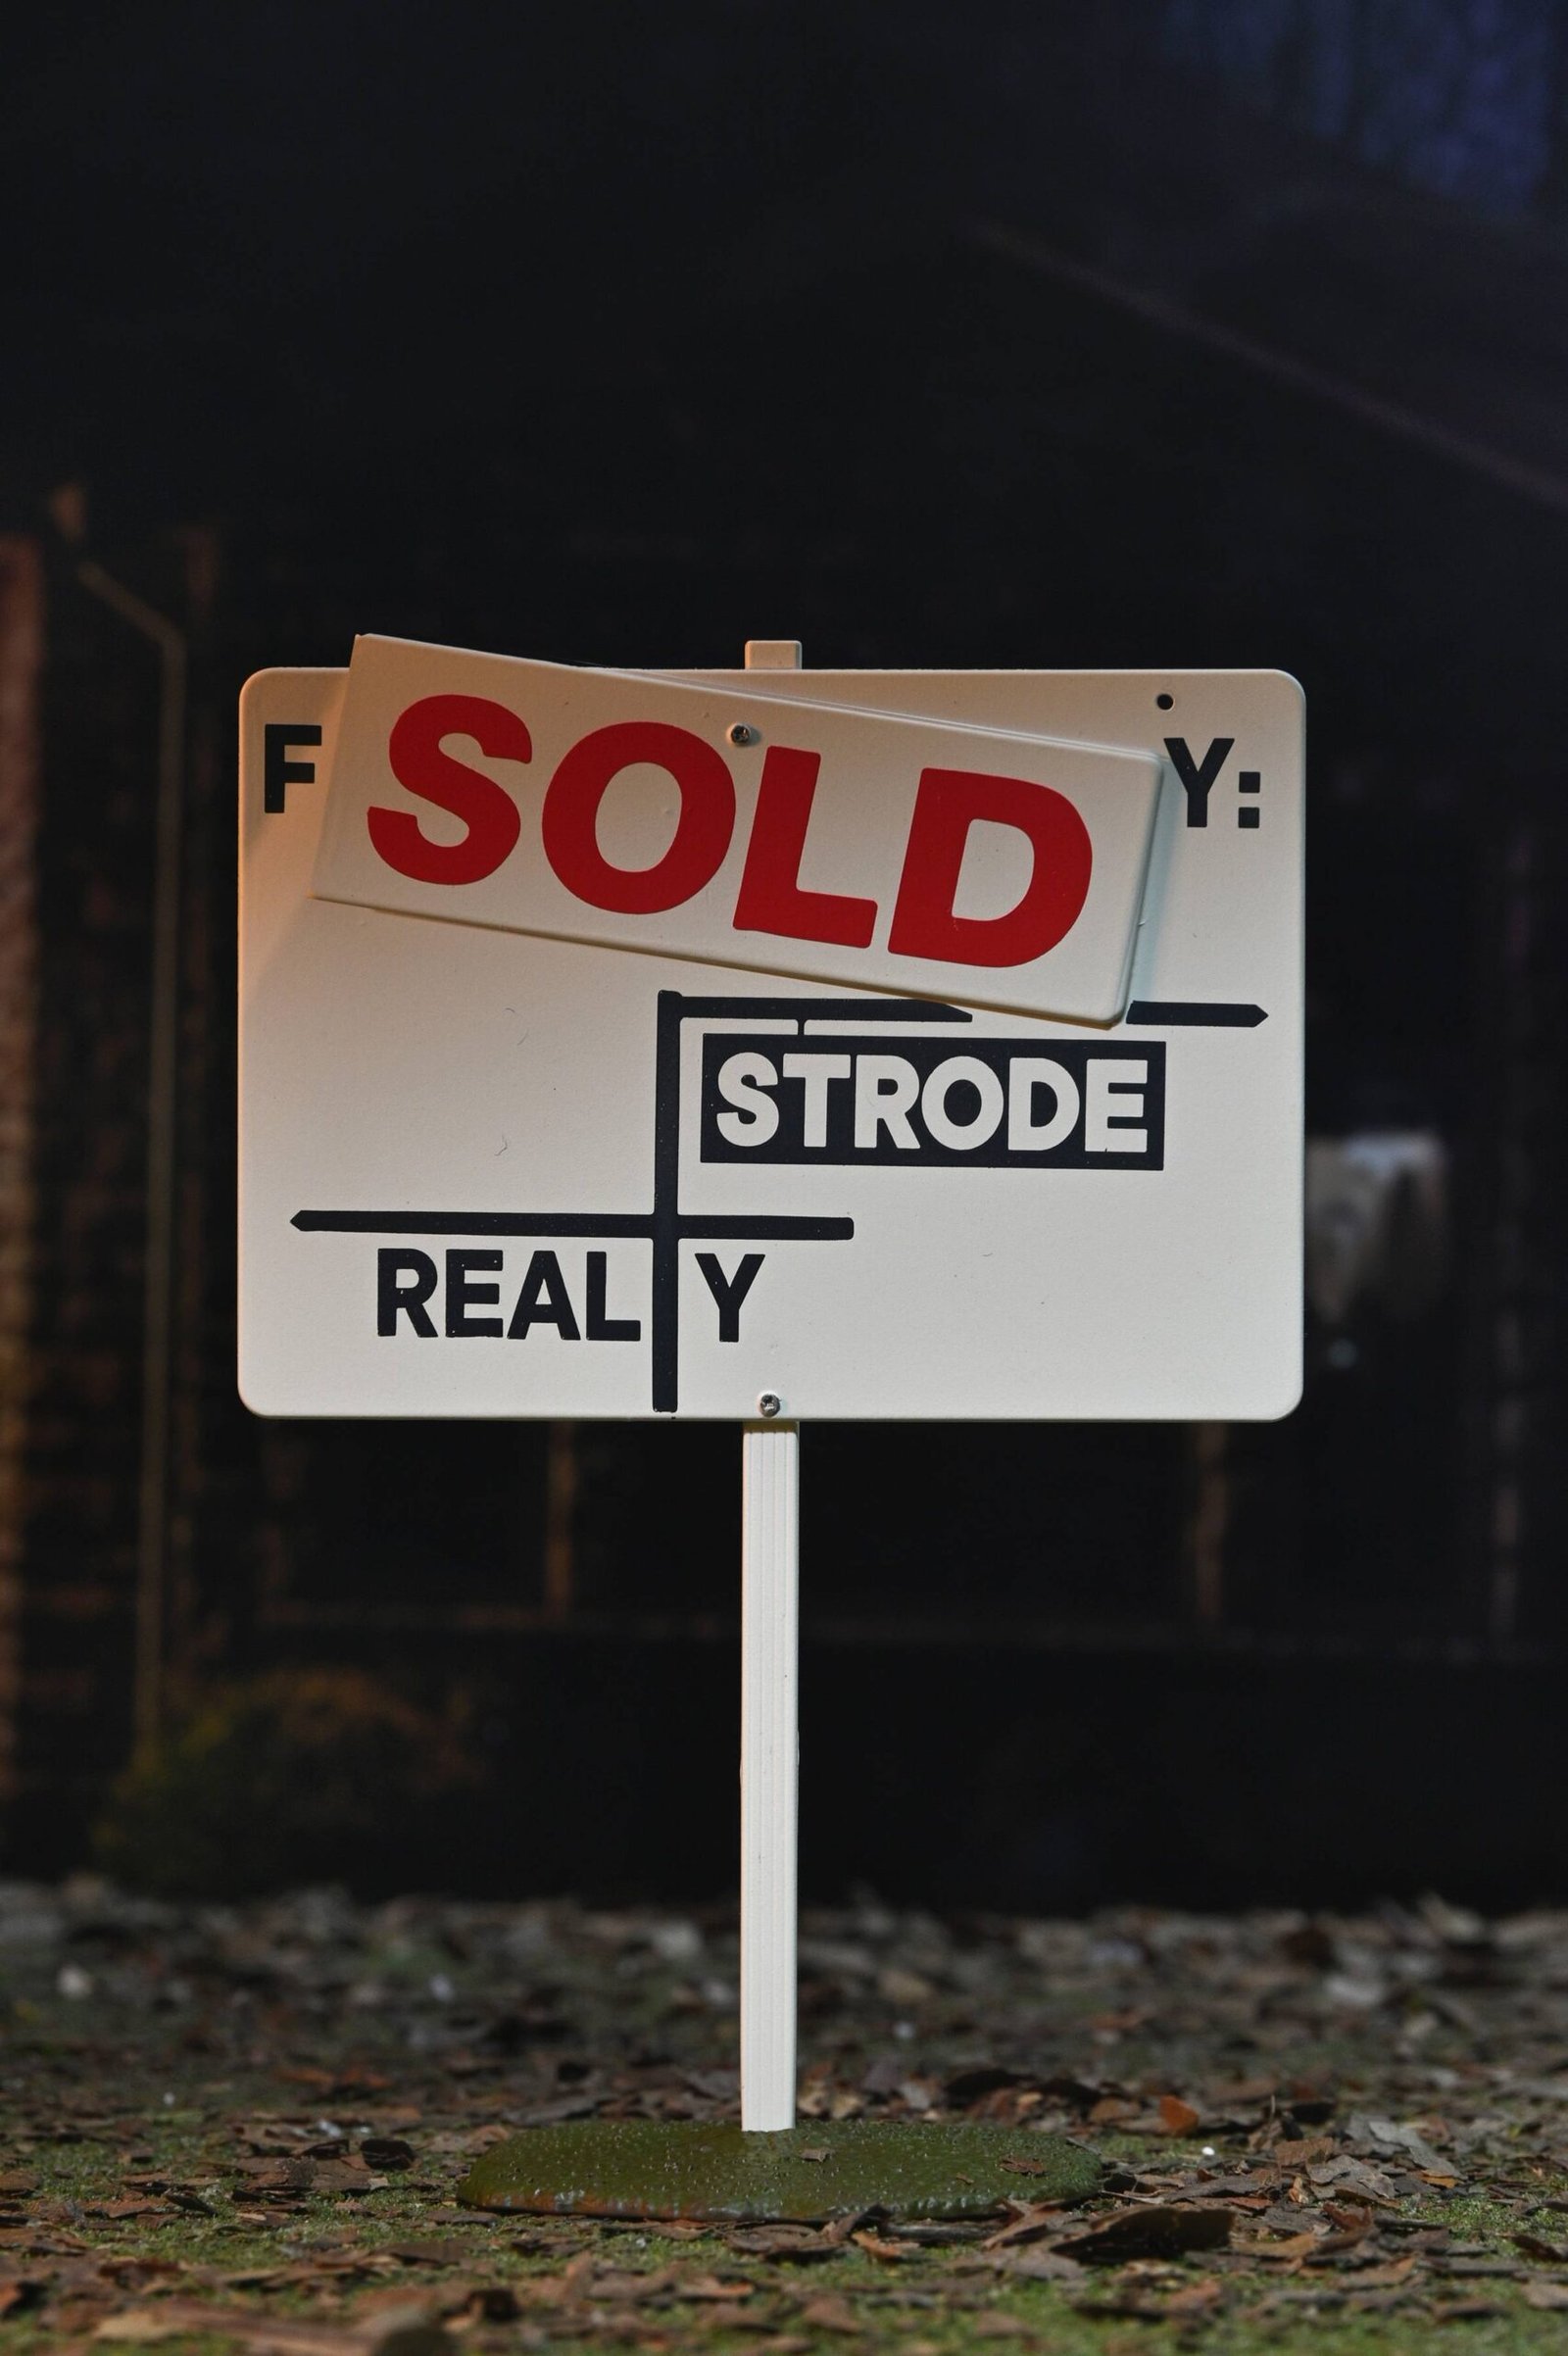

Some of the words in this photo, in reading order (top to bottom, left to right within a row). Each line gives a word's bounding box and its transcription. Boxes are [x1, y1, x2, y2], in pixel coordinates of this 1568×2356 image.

[264, 723, 322, 814] F
[1162, 737, 1261, 829] Y:
[367, 692, 1093, 967] SOLD
[716, 1052, 1149, 1153] STRODE
